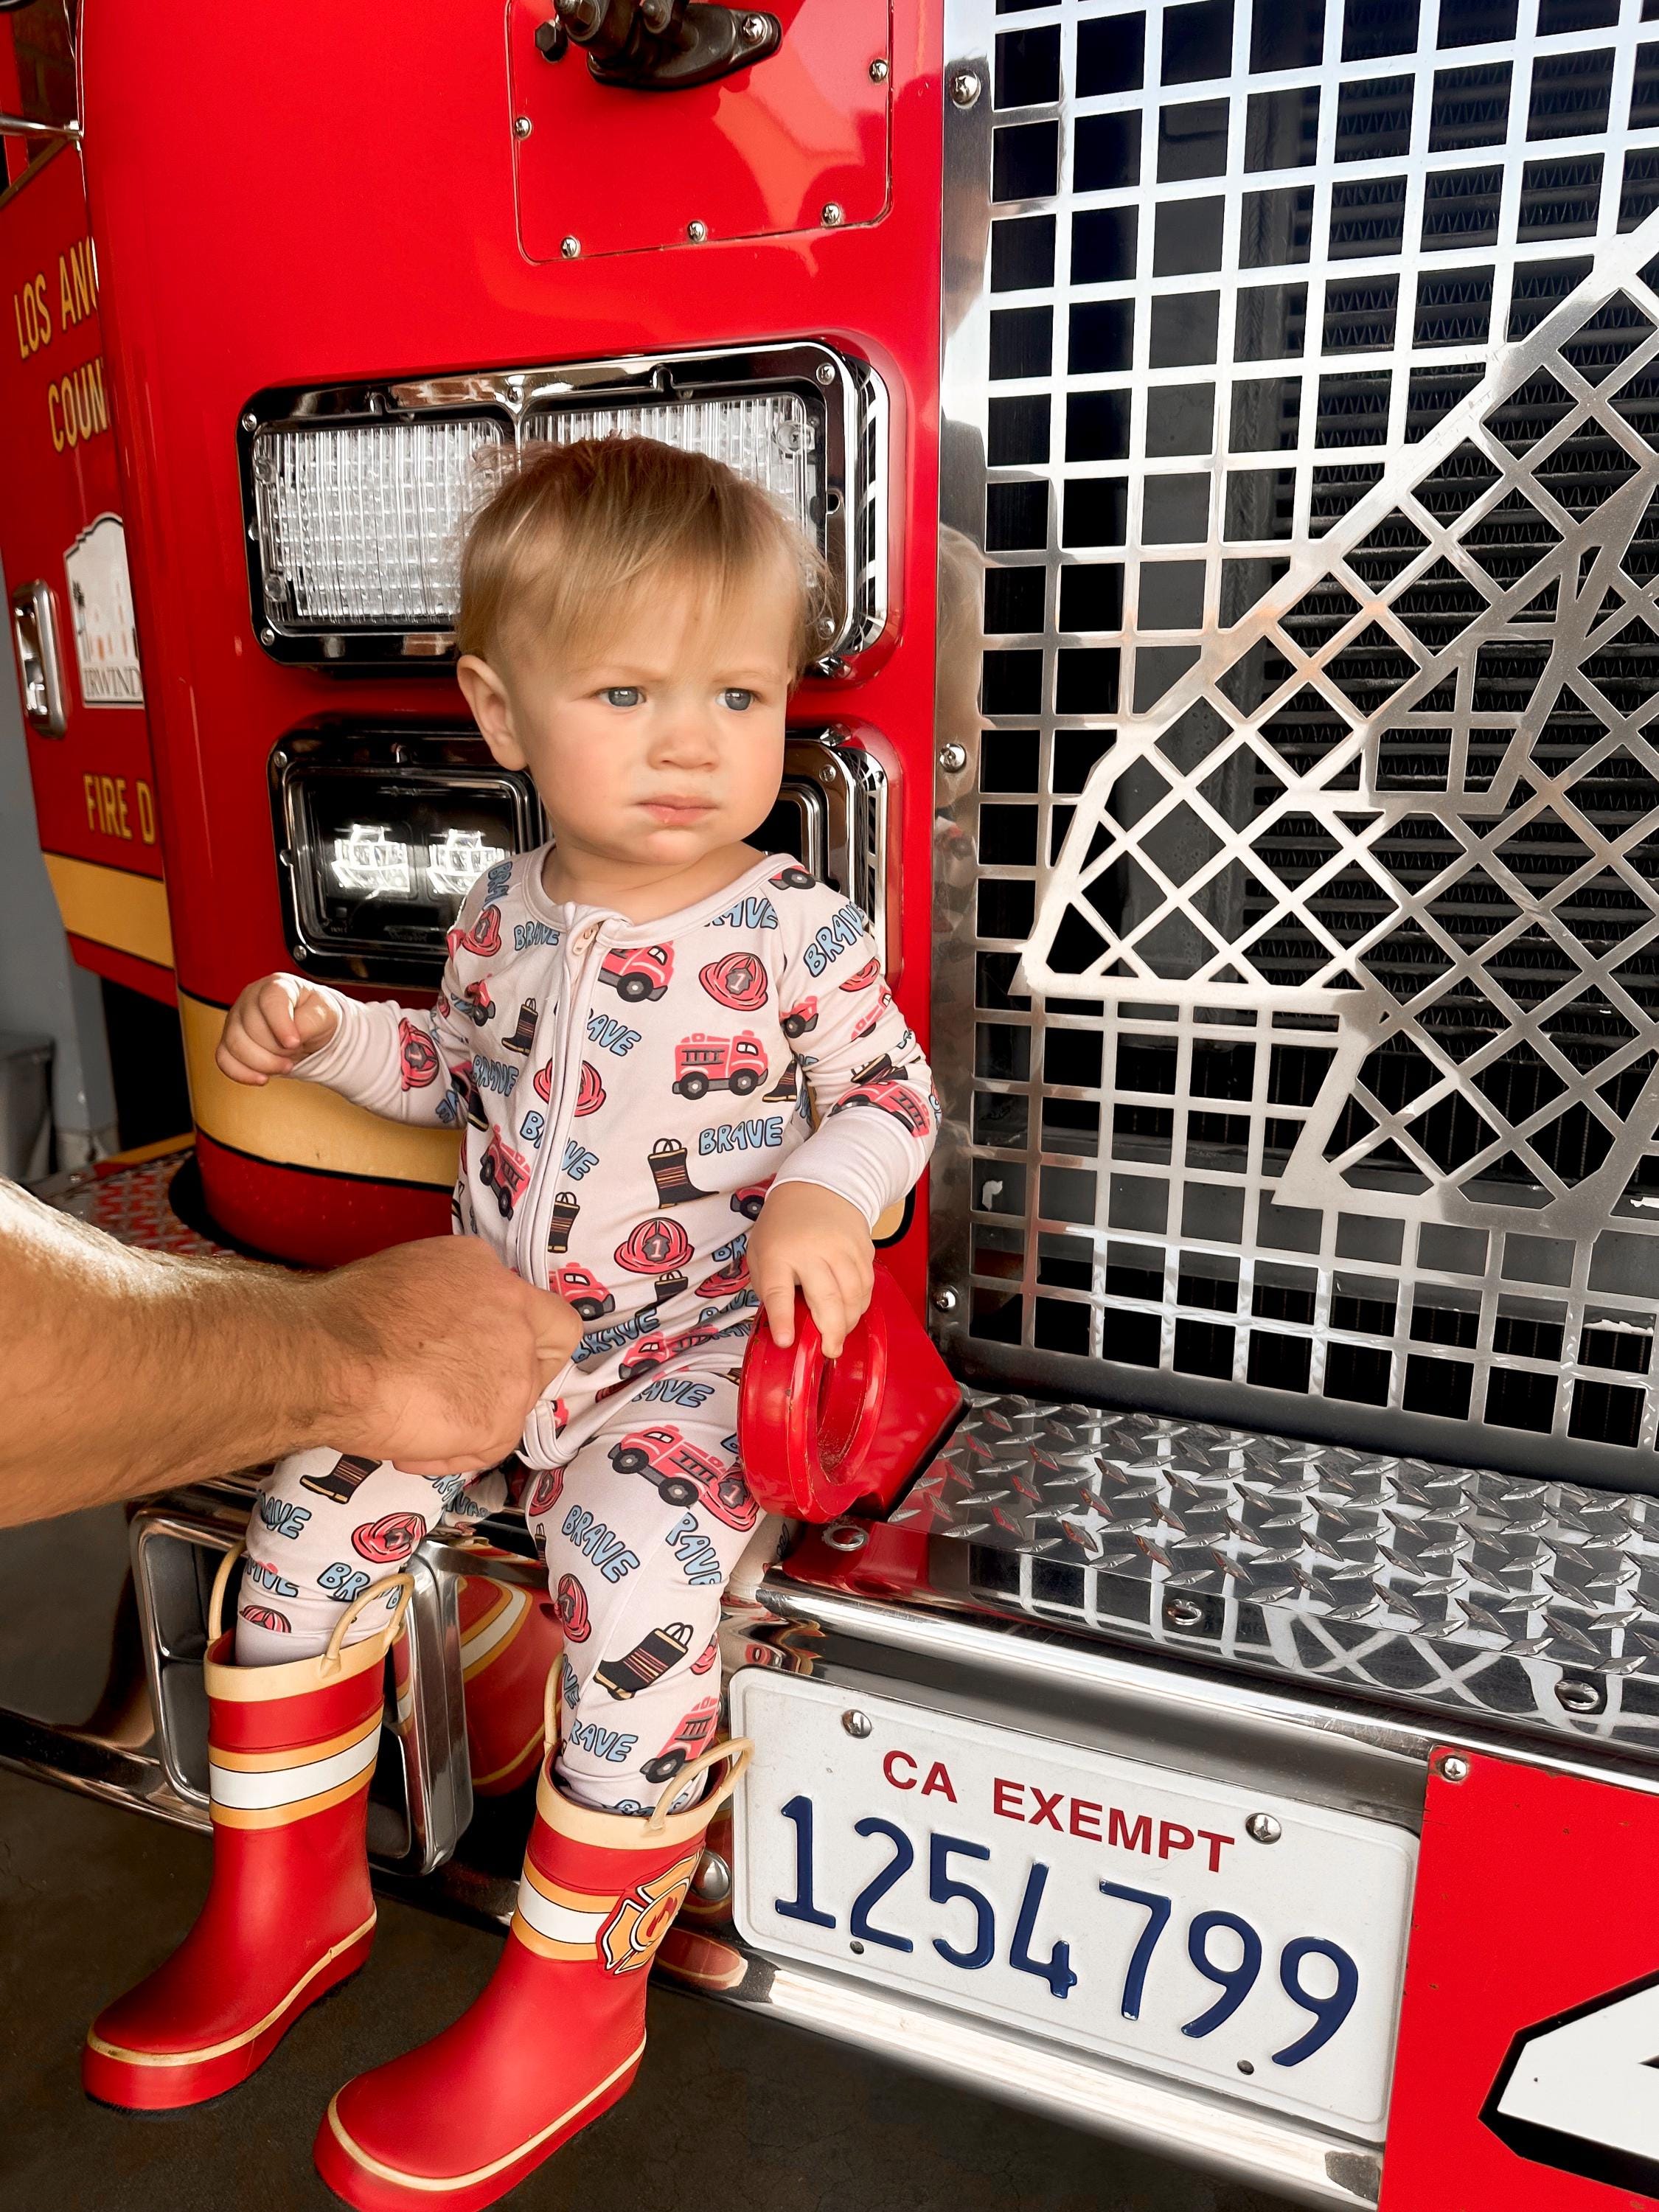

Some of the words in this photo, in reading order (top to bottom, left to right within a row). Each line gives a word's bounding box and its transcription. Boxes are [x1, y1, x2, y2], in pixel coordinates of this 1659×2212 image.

[13, 272, 52, 360] LOS
[48, 356, 111, 451] COUN
[83, 773, 133, 841] FIRE
[803, 901, 865, 978] BRAV
[587, 1007, 641, 1057] AVE
[473, 1054, 519, 1097] BRAVE
[698, 1116, 783, 1155] BRAVE
[562, 1505, 640, 1584] BRAVE
[569, 1718, 639, 1762] RAVE
[883, 1750, 958, 1804] CA
[993, 1777, 1235, 1873] EXEMPT
[775, 1795, 1359, 2067] 1254799
